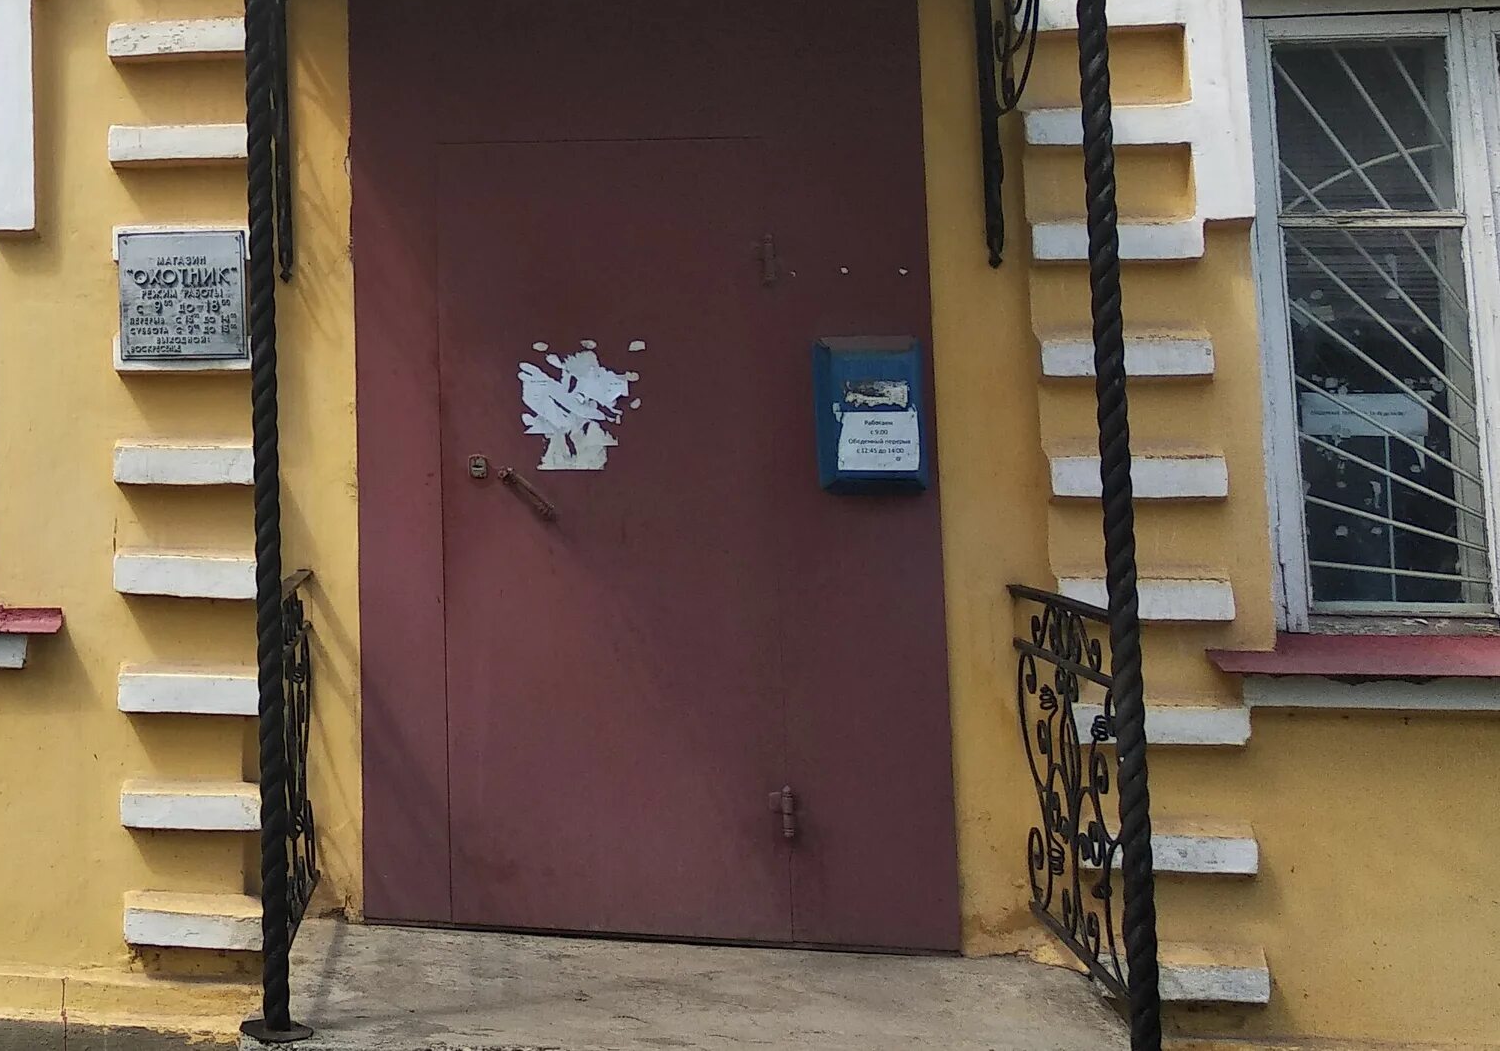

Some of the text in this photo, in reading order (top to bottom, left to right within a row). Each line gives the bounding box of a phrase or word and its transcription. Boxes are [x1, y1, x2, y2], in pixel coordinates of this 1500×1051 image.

[157, 256, 207, 266] МАГАЗИН
[126, 267, 238, 287] "ОХОТНИК"
[142, 289, 224, 299] РЕЖИМ РАБОТЫ
[179, 304, 196, 314] ДО
[130, 317, 165, 326] ПЕРЕРЫВ
[130, 327, 169, 336] СУББОТА
